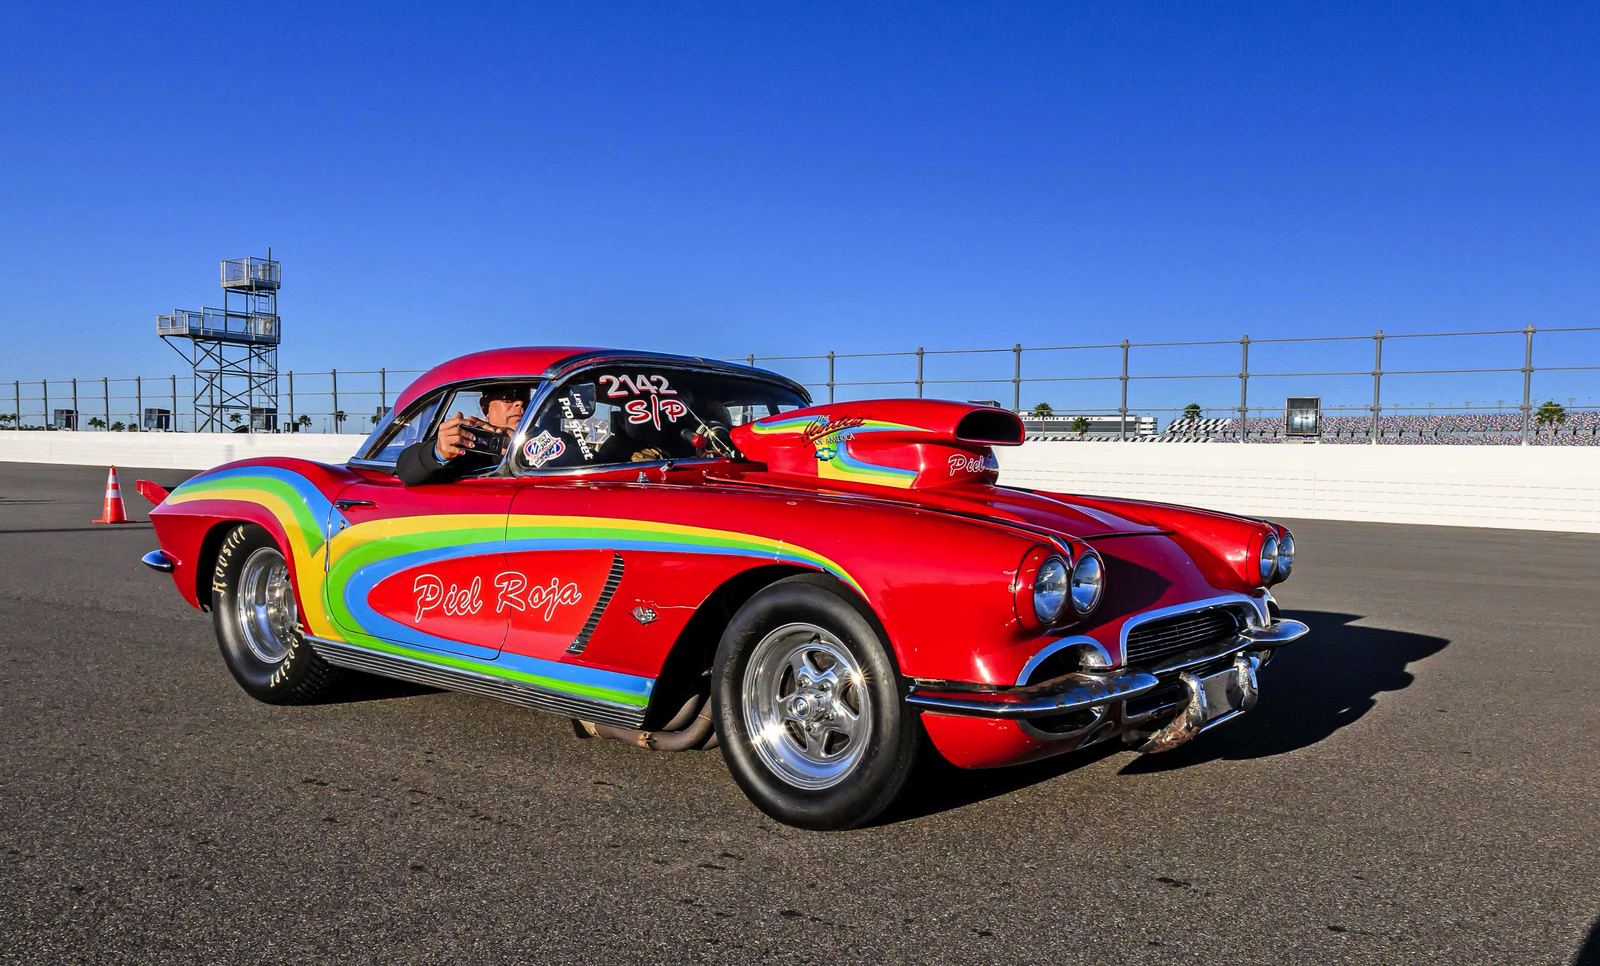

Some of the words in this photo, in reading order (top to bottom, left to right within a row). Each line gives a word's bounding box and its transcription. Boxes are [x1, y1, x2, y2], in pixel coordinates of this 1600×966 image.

[598, 374, 678, 398] 2142
[573, 393, 589, 415] Legal
[558, 397, 575, 419] Pro
[569, 419, 594, 461] Street
[826, 433, 856, 445] AMERICA
[947, 453, 986, 477] Piel
[211, 525, 246, 598] Hoosier
[413, 573, 483, 623] Piel
[494, 571, 582, 621] Roja
